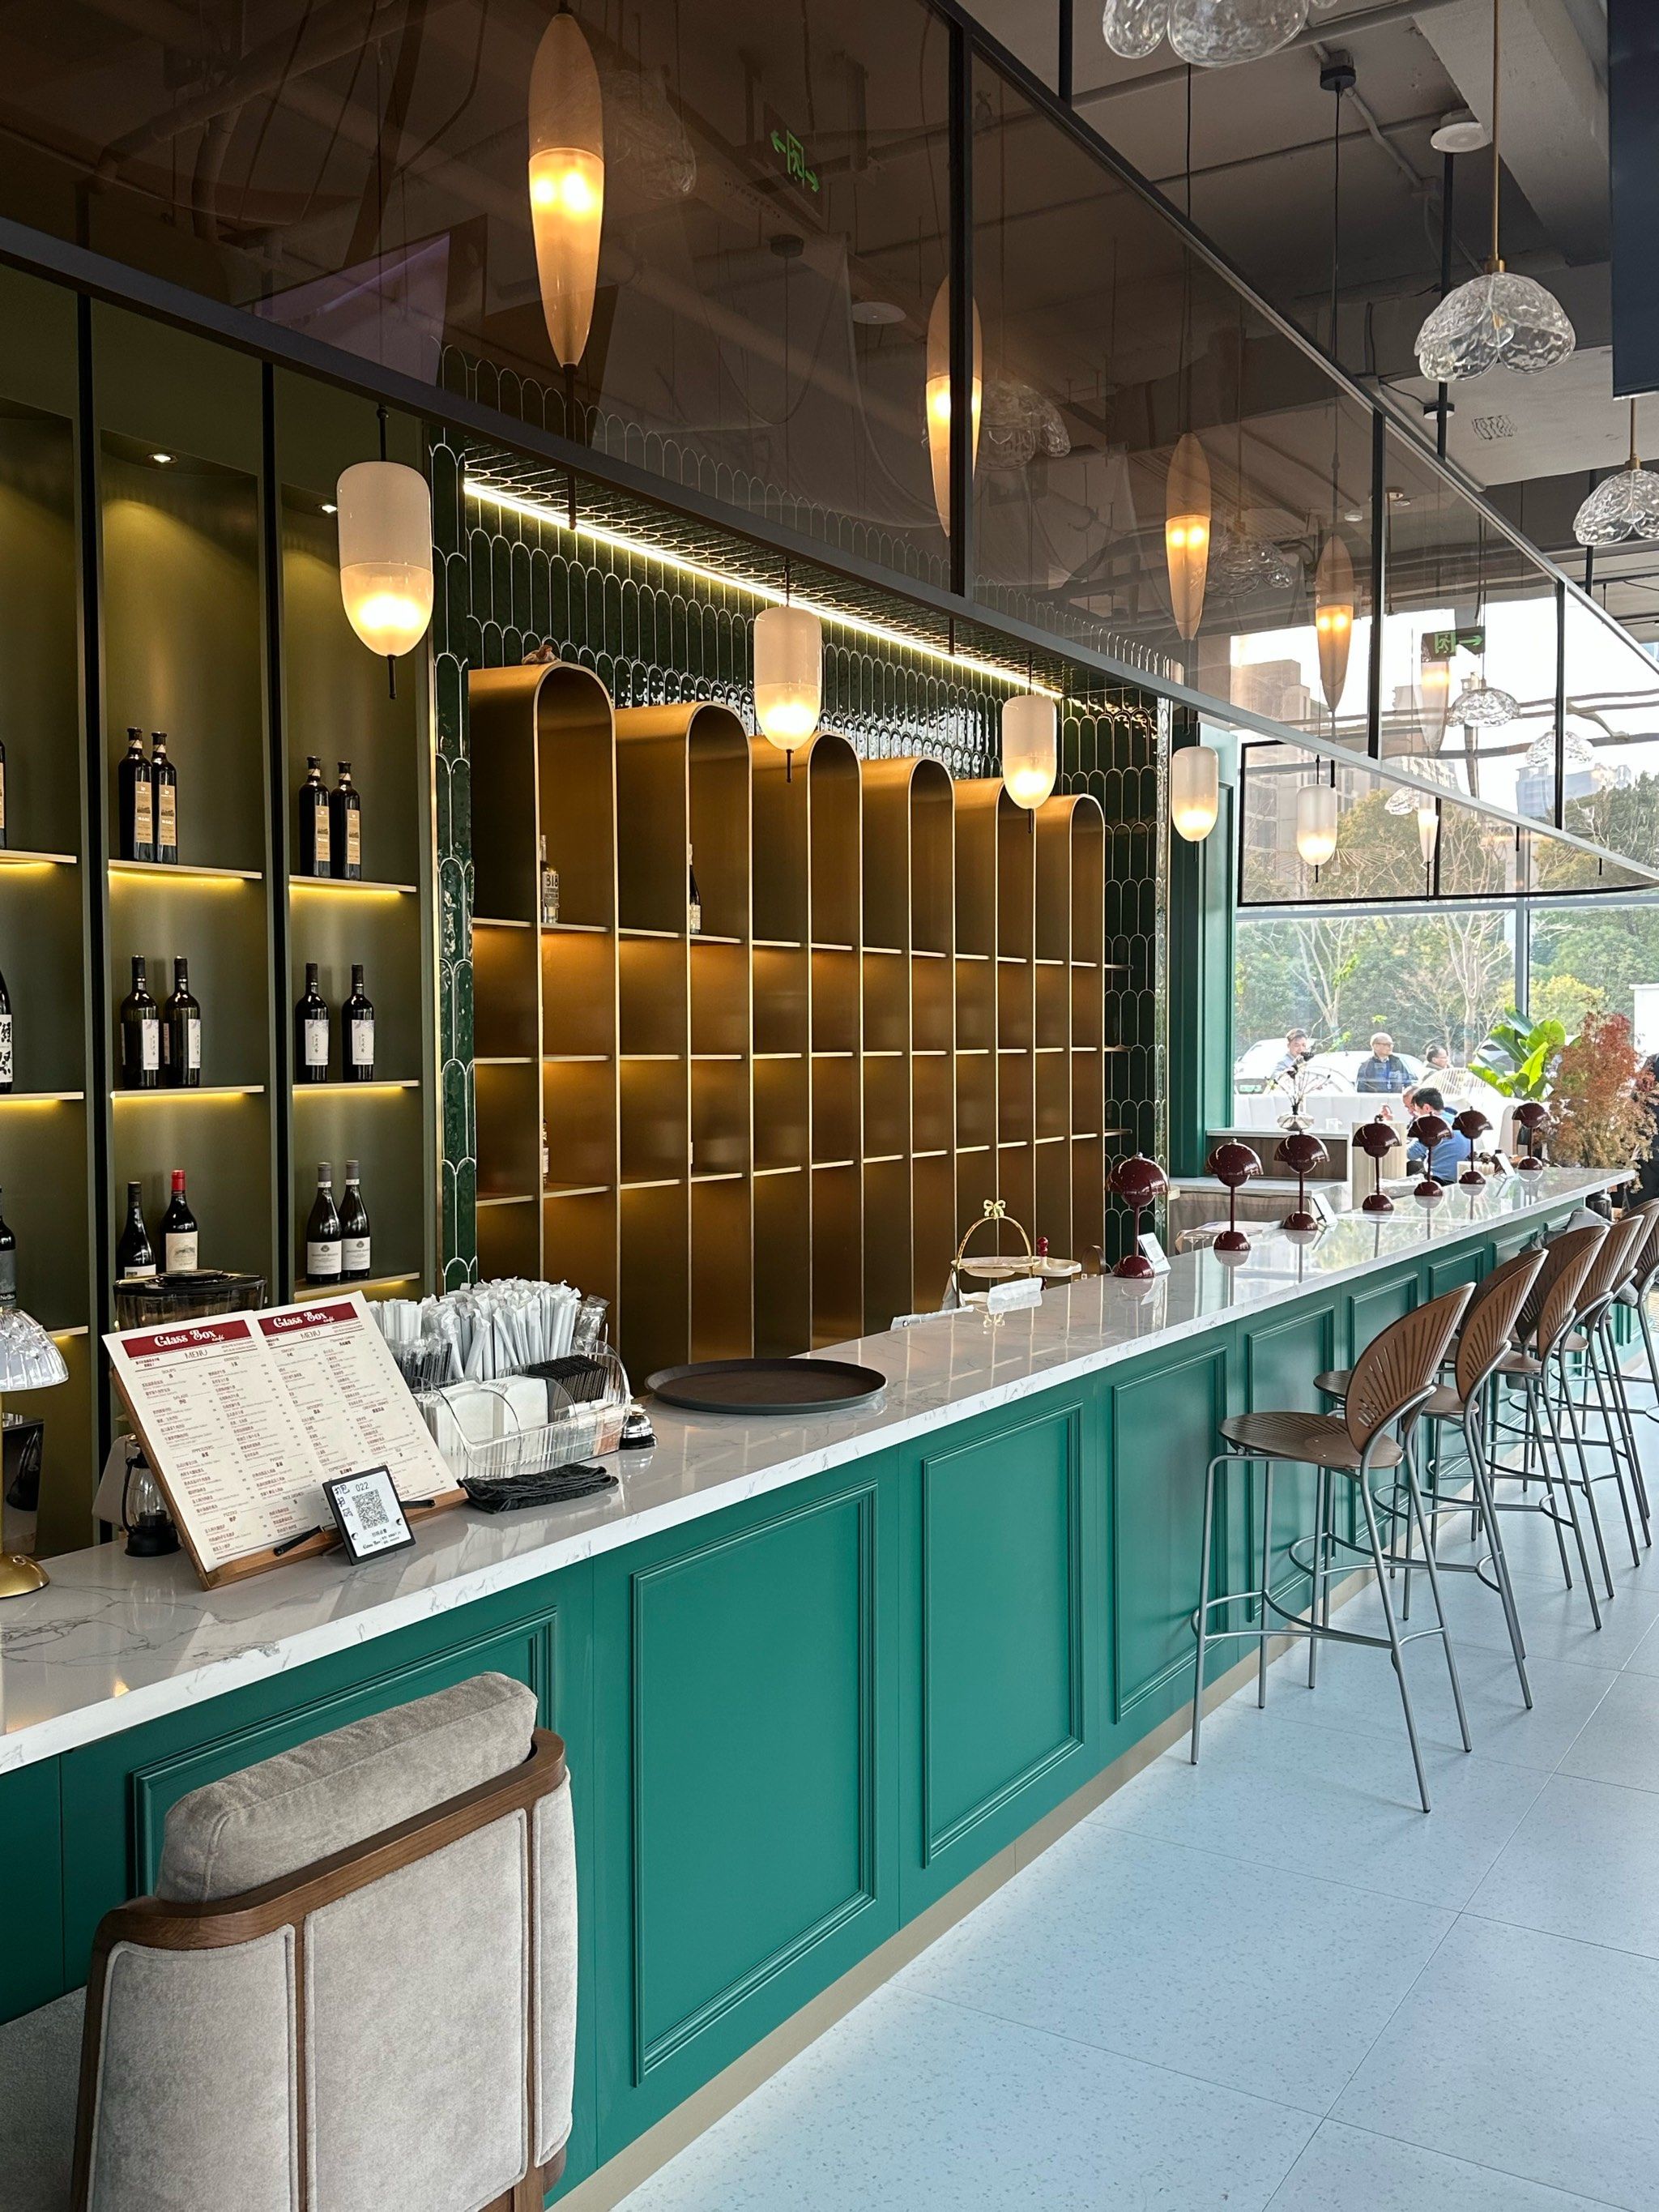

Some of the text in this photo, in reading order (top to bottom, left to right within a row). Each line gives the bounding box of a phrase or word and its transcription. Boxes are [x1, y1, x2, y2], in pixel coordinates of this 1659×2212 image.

[273, 1311, 327, 1328] Glass Box
[154, 1329, 216, 1347] Glass Box
[301, 1330, 321, 1339] MENU
[184, 1349, 208, 1360] MENU
[355, 1482, 369, 1492] 022
